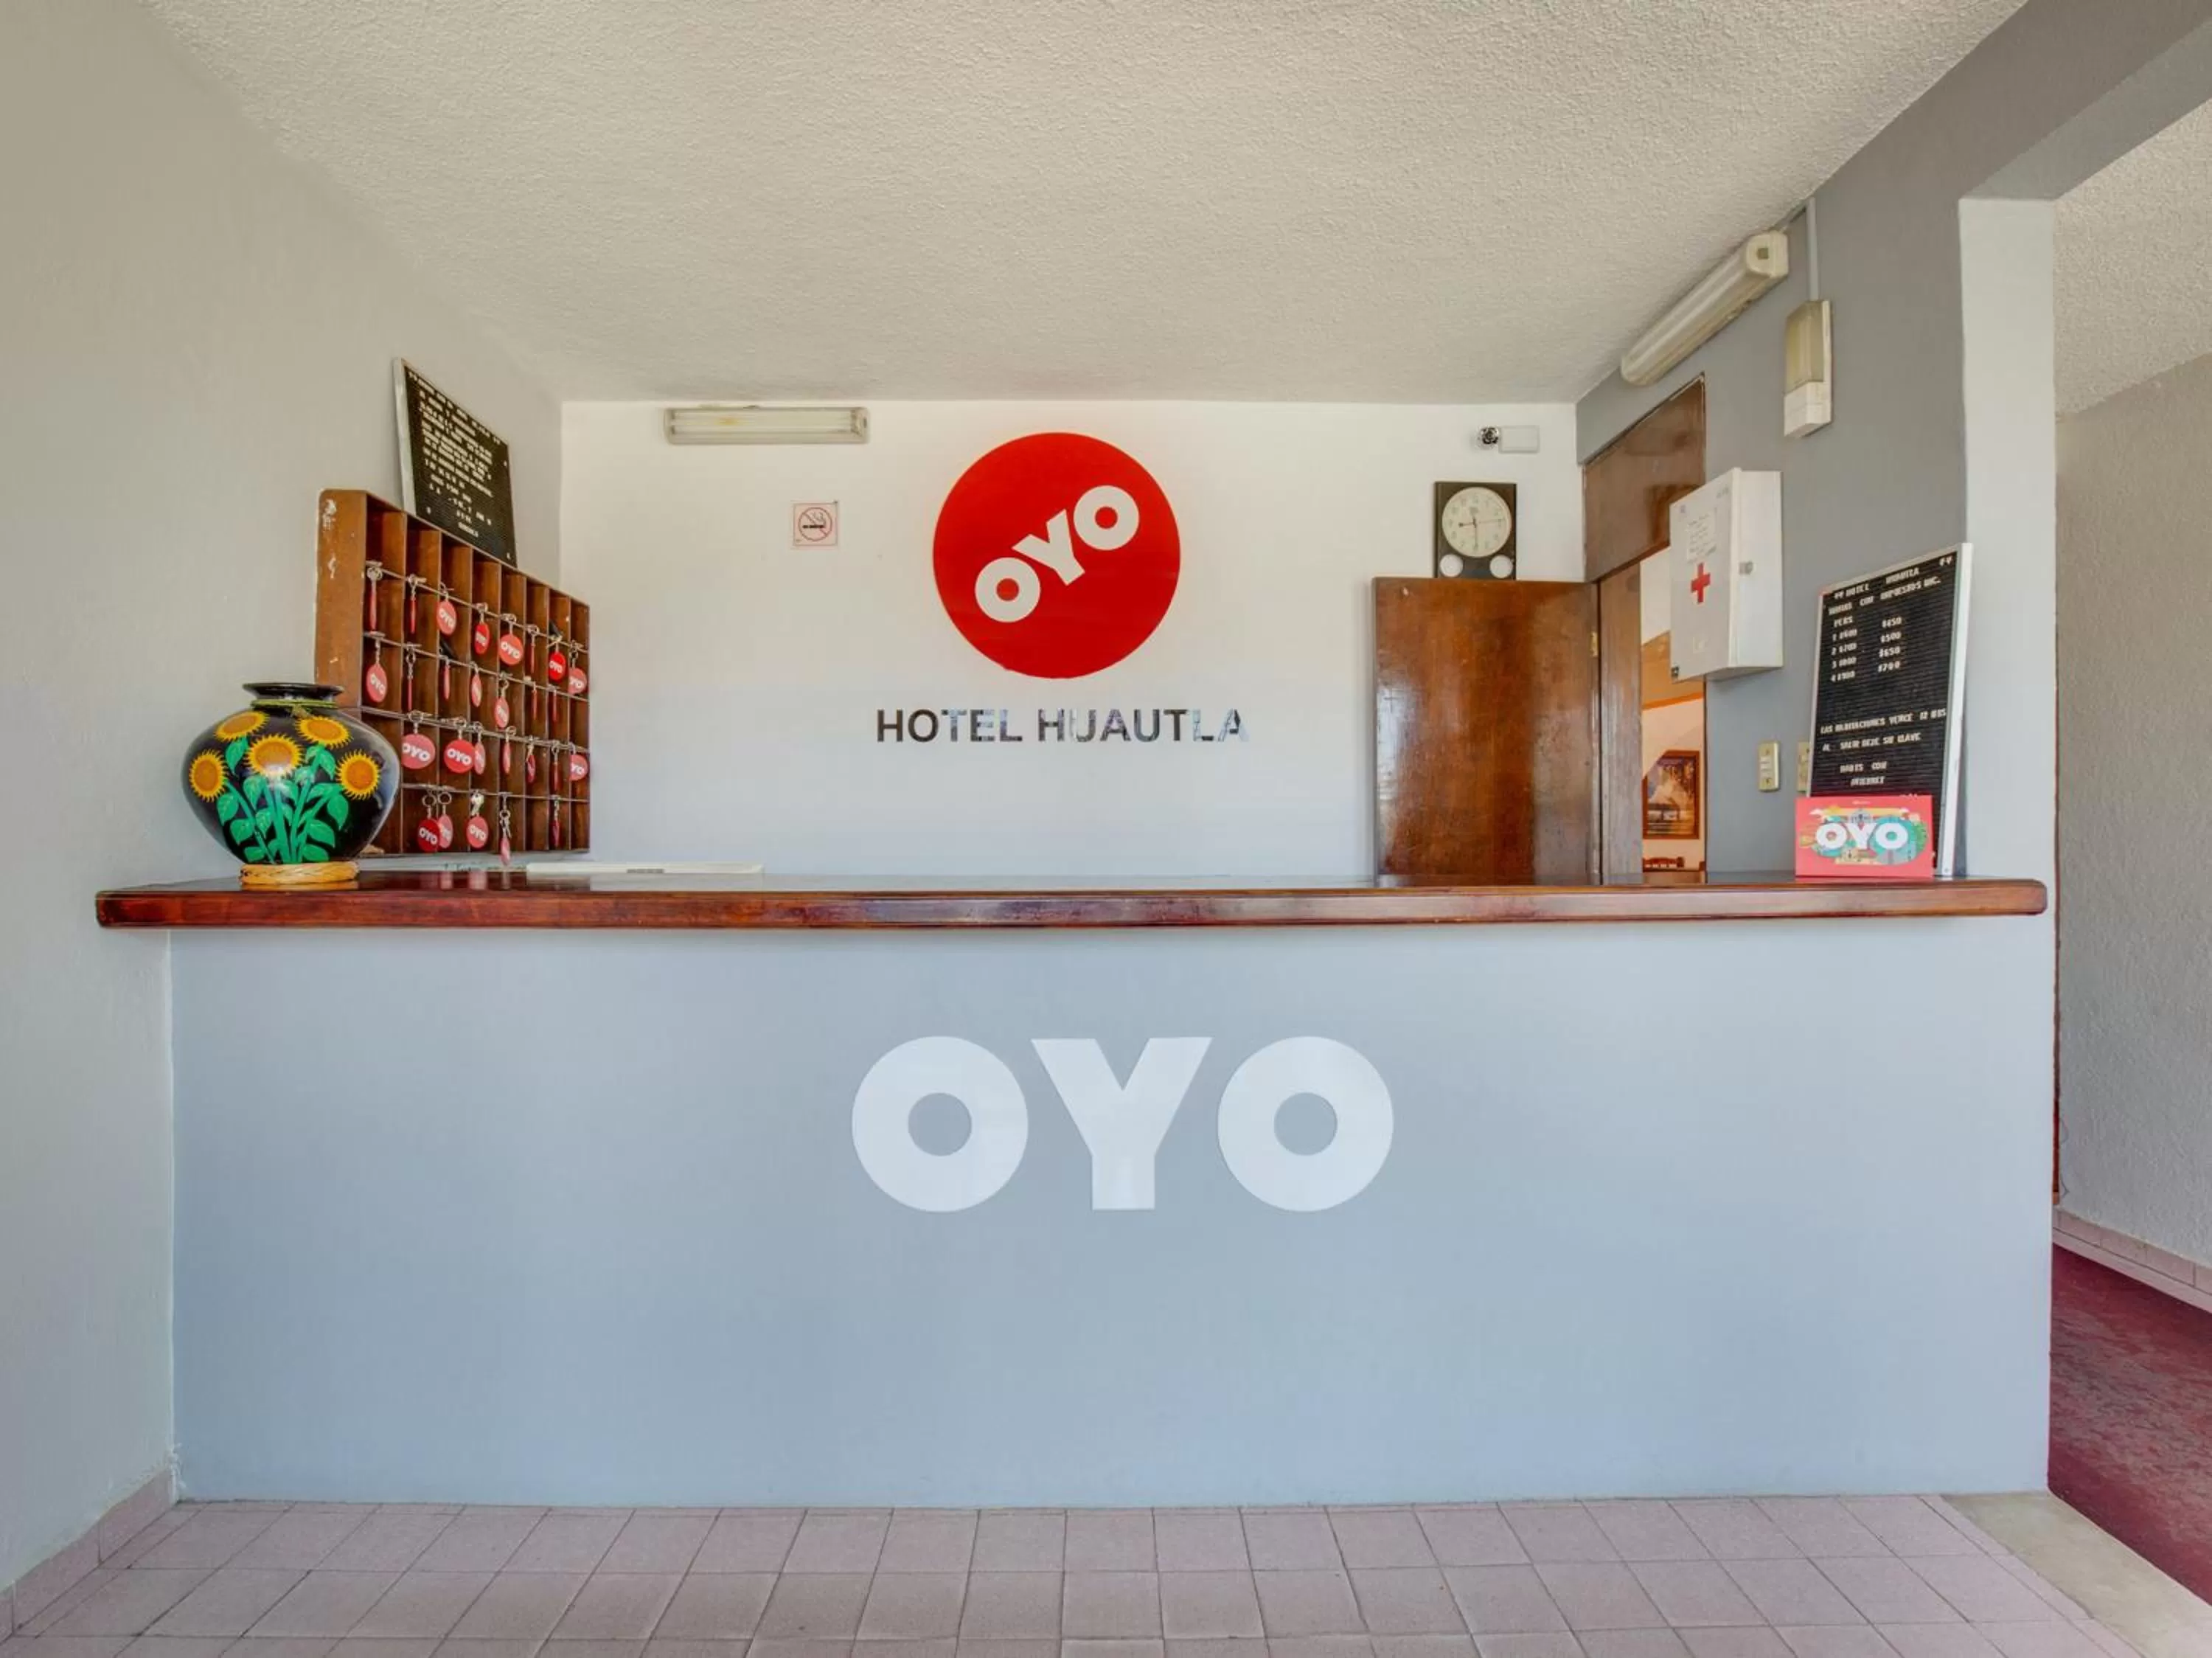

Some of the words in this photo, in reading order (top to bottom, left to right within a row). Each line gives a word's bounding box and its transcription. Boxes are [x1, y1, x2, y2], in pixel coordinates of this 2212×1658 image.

[975, 485, 1139, 622] OYO
[500, 641, 520, 659] OYO
[877, 709, 1023, 742] HOTEL
[1038, 709, 1250, 742] HUAUTLA
[403, 743, 431, 762] OYO
[447, 748, 472, 766] OYO
[419, 828, 437, 844] OYO
[468, 824, 486, 841] OYO
[1815, 822, 1909, 850] OYO
[852, 1036, 1394, 1212] OYO
